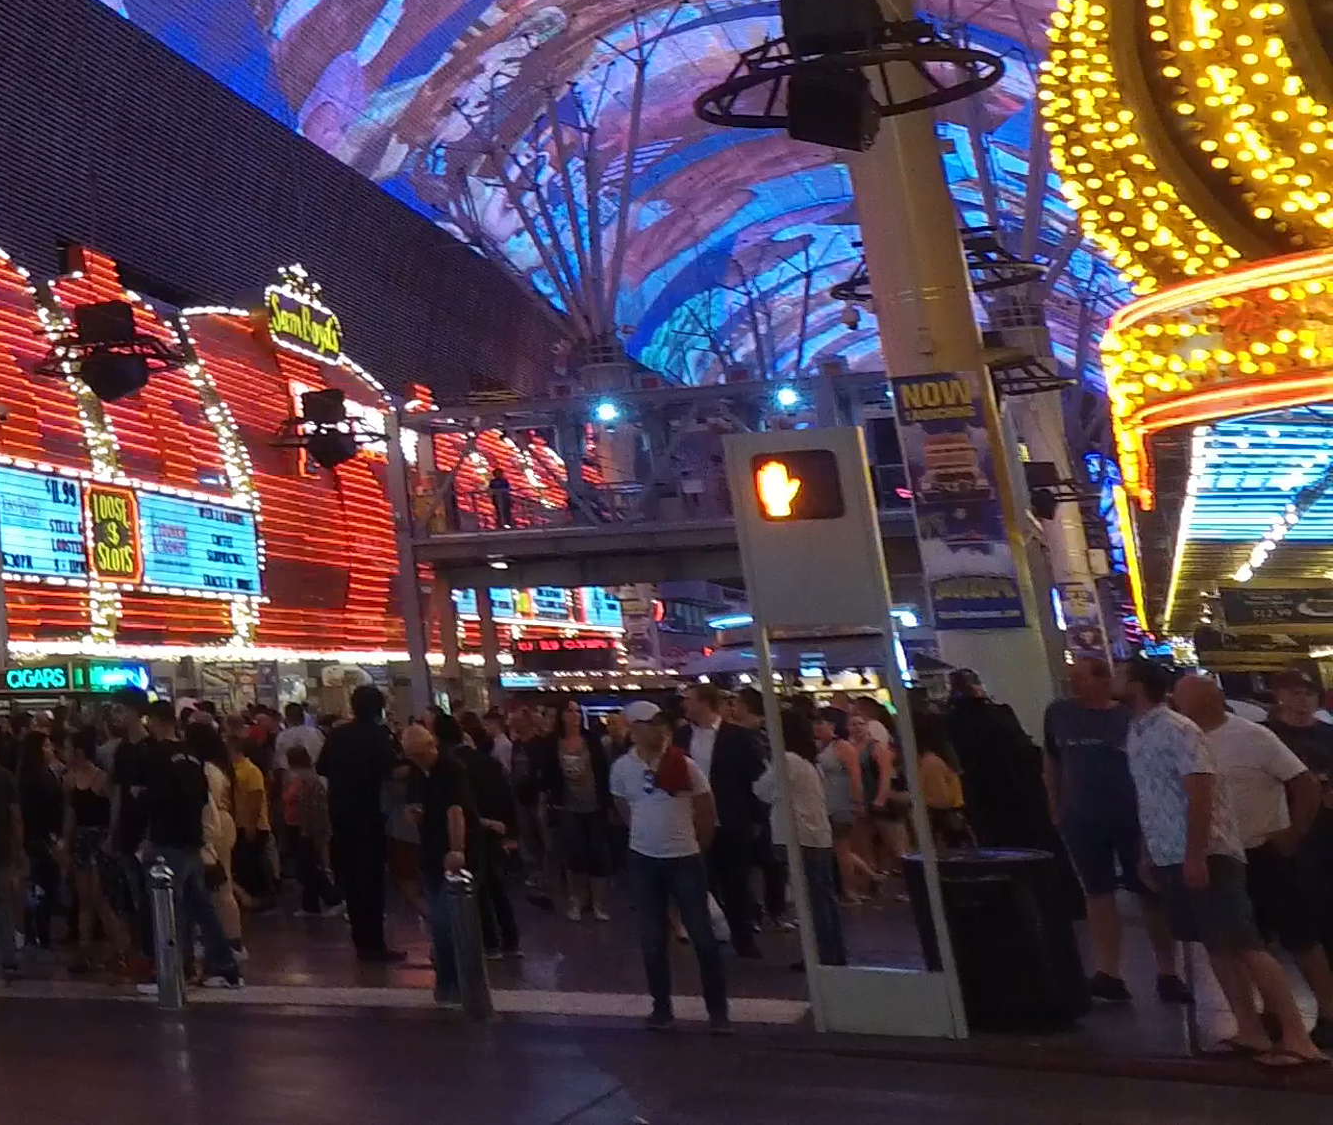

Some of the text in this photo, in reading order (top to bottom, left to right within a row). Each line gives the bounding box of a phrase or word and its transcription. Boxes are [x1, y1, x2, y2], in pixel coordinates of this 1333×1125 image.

[271, 293, 341, 355] Sam Boyd's
[899, 378, 974, 408] NOW
[92, 493, 130, 529] LOOSE
[104, 521, 121, 546] $
[96, 540, 134, 574] SLOTS
[6, 667, 67, 689] CIGARS
